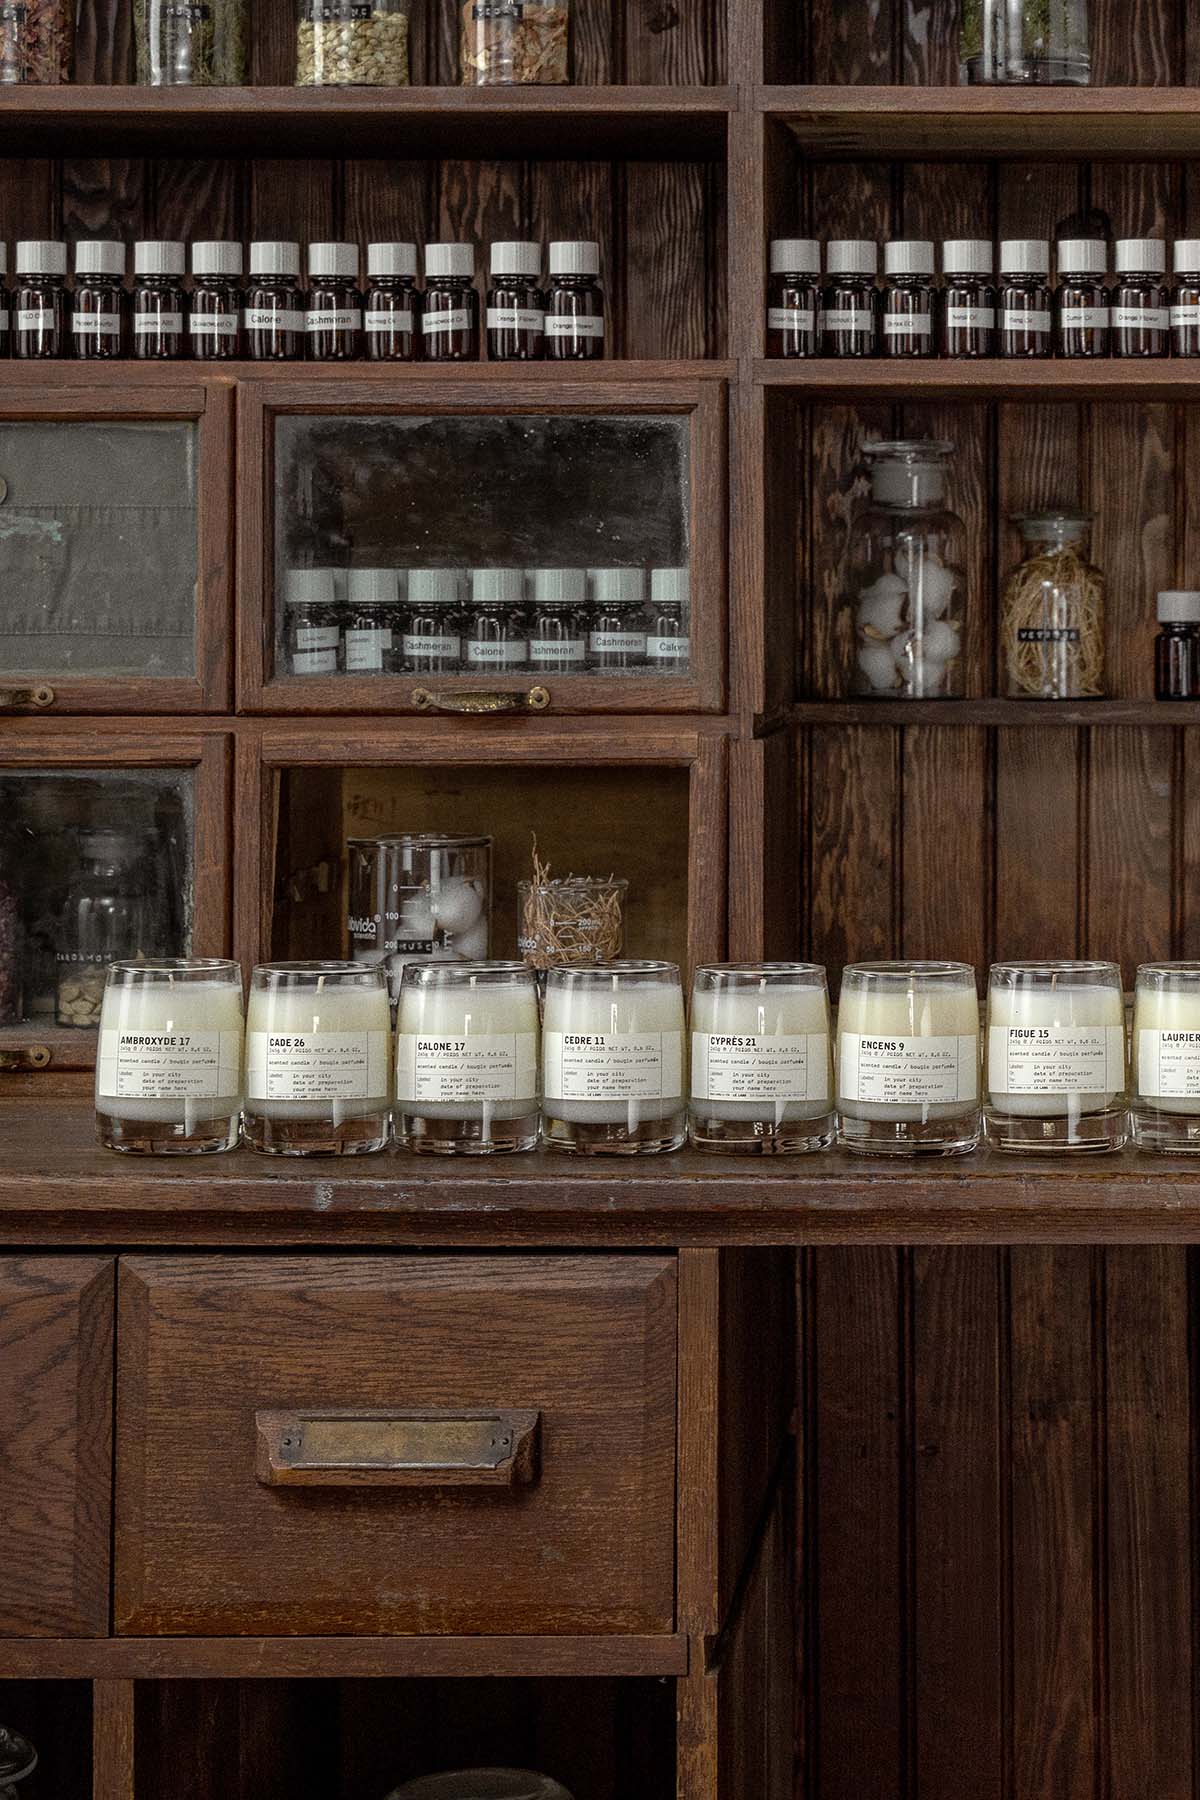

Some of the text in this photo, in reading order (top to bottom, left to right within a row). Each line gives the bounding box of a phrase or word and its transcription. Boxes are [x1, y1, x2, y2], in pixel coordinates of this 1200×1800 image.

[385, 912, 399, 920] 100
[1010, 1030, 1049, 1038] FIGUE 15
[121, 1037, 176, 1045] AMBROXYDE
[565, 1036, 591, 1044] CEDRE
[711, 1036, 756, 1046] CYPRÈS 21
[418, 1042, 465, 1051] CALONE 17
[862, 1041, 896, 1050] ENCENS
